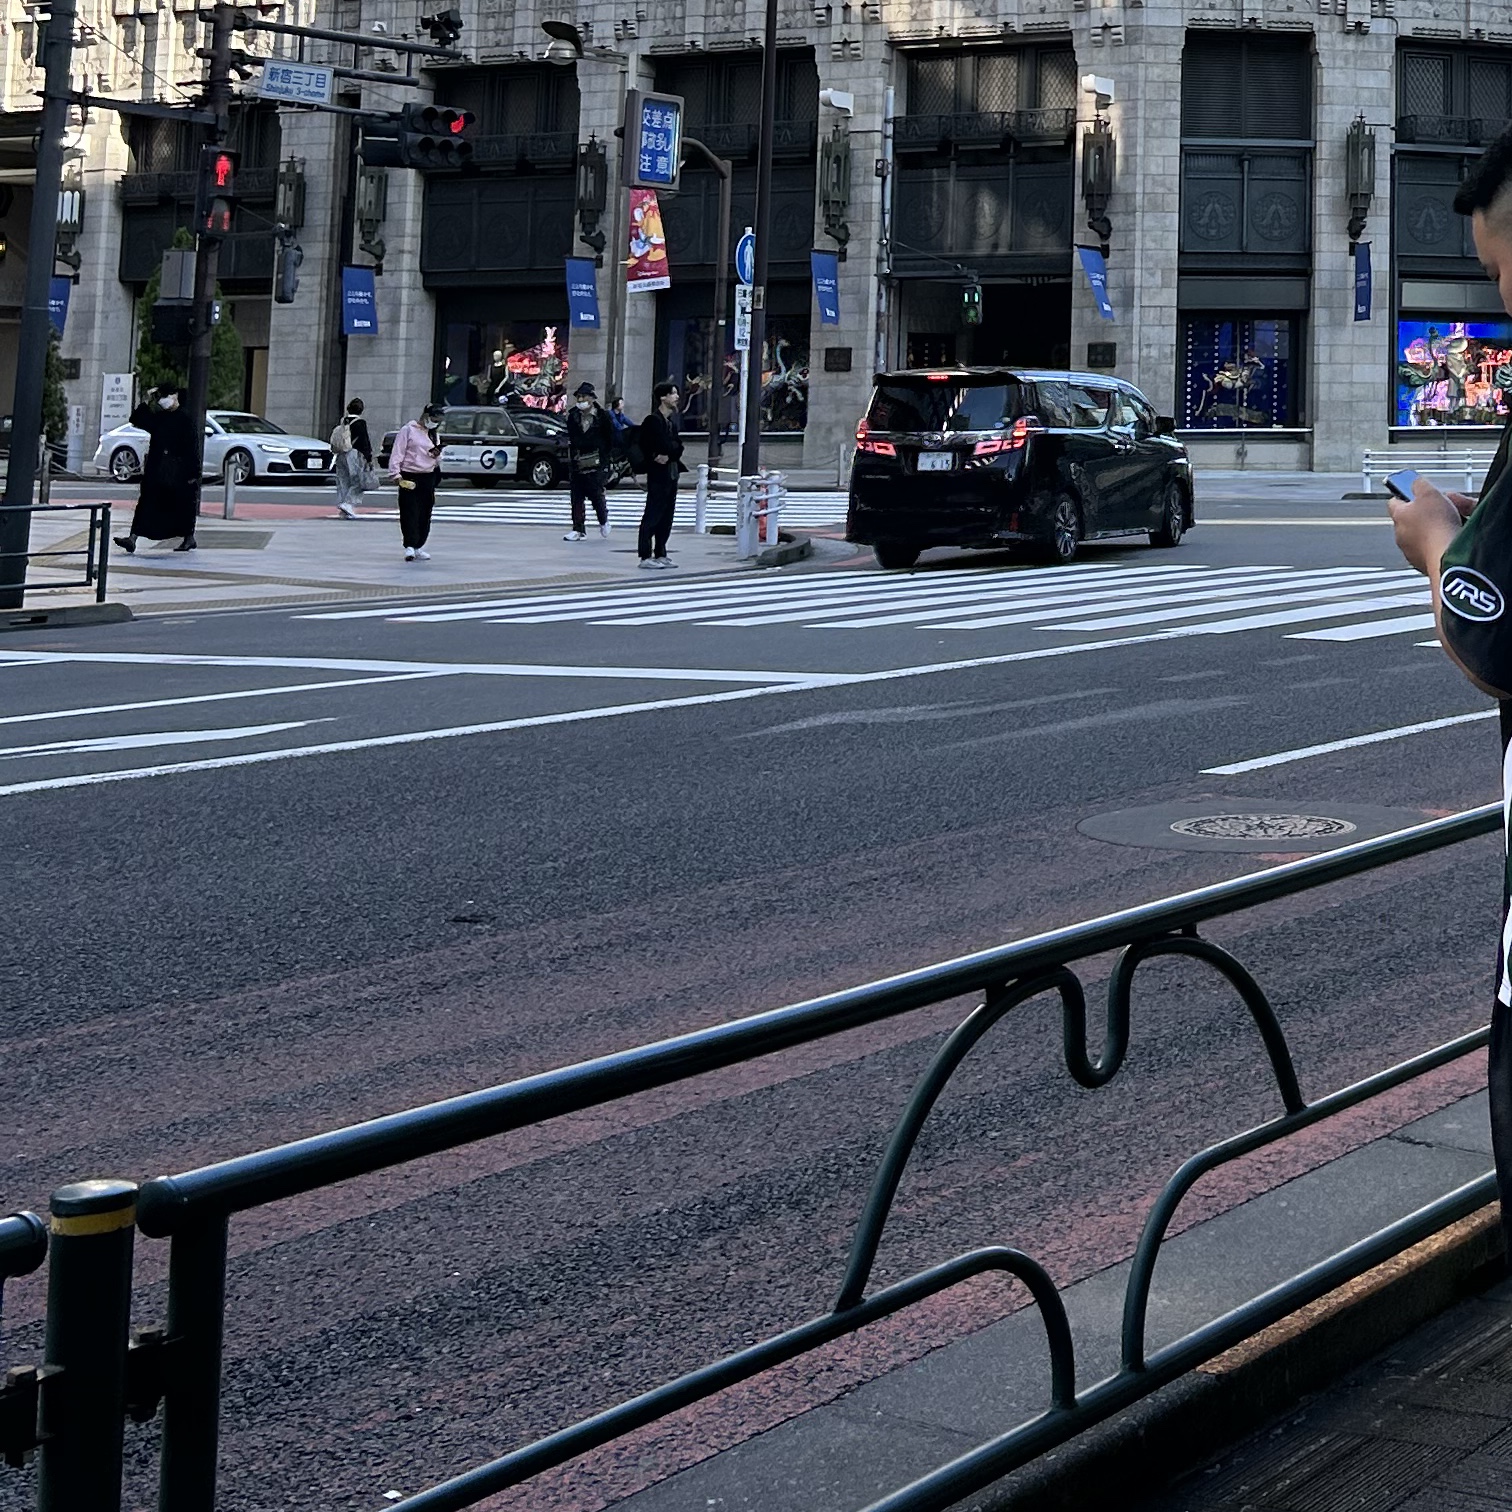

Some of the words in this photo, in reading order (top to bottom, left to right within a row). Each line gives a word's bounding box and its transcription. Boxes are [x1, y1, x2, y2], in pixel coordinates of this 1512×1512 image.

[268, 66, 327, 89] 新宿三丁目
[480, 449, 508, 470] GO
